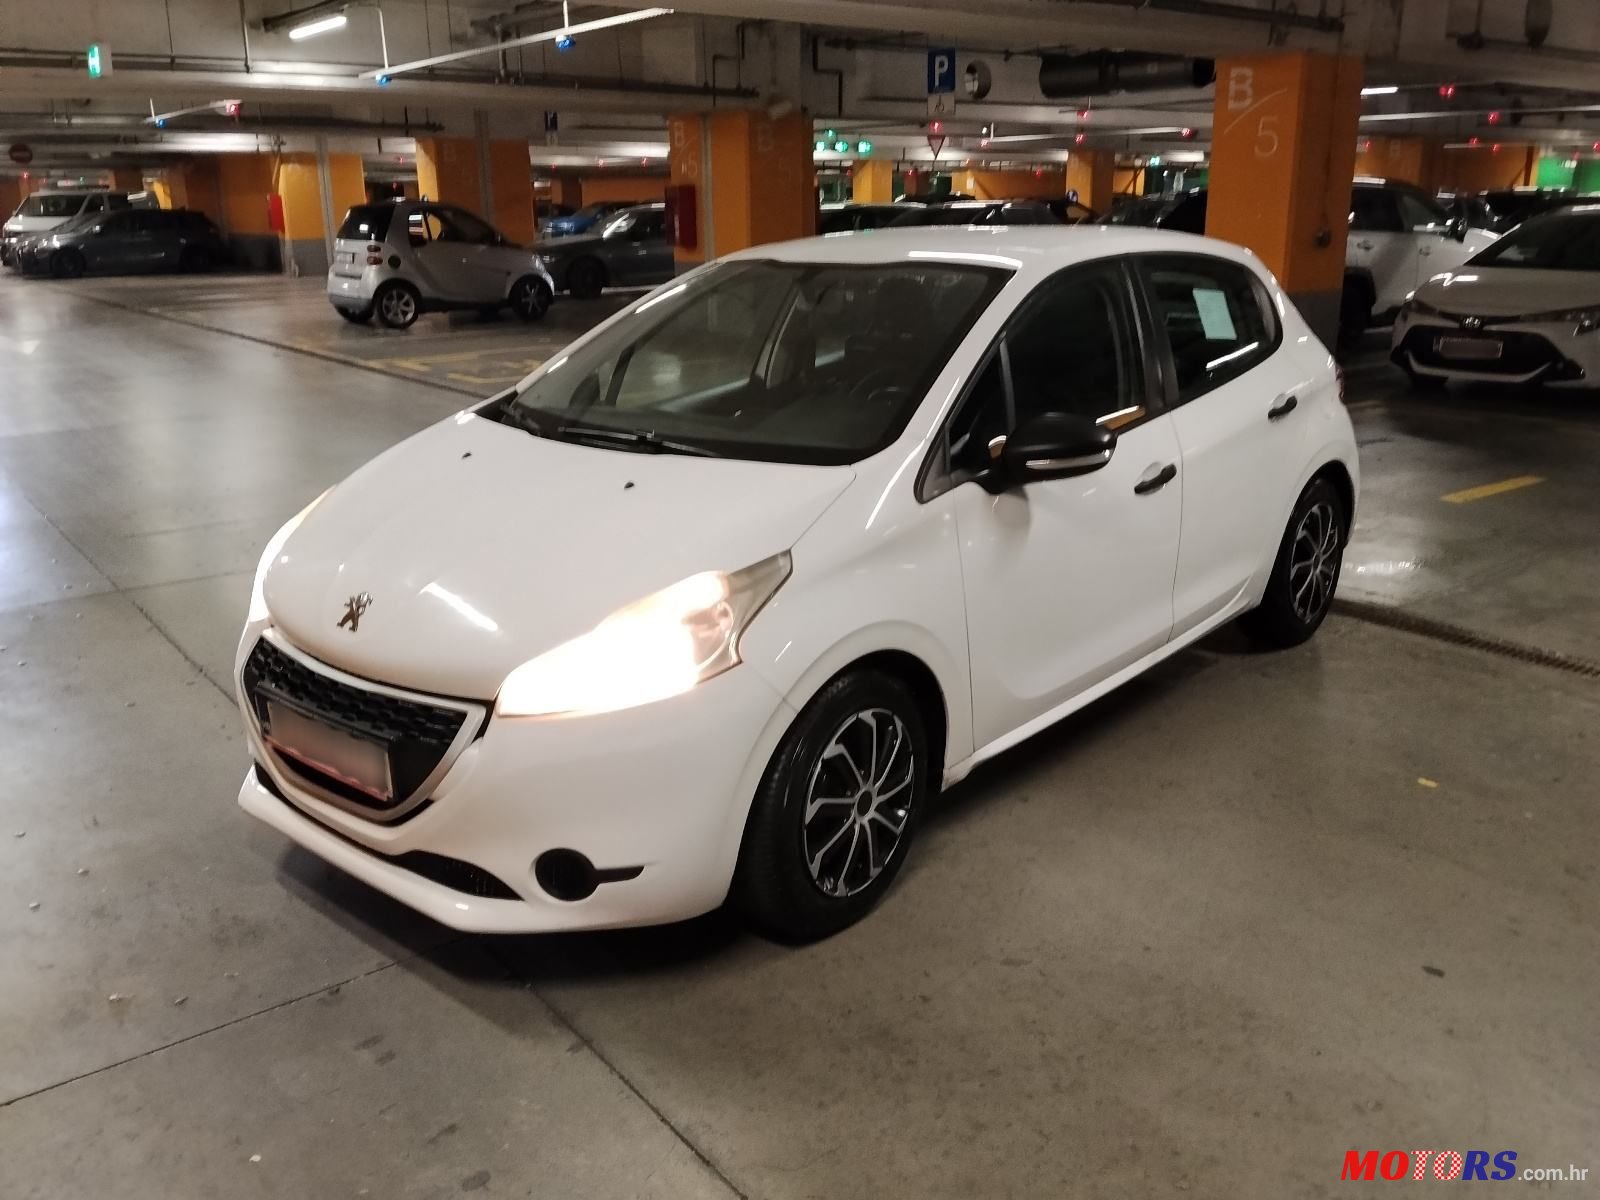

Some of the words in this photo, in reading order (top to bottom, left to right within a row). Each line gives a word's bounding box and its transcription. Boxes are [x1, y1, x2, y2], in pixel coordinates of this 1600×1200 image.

[934, 55, 949, 88] P
[1228, 67, 1253, 112] B
[1254, 115, 1279, 158] 5
